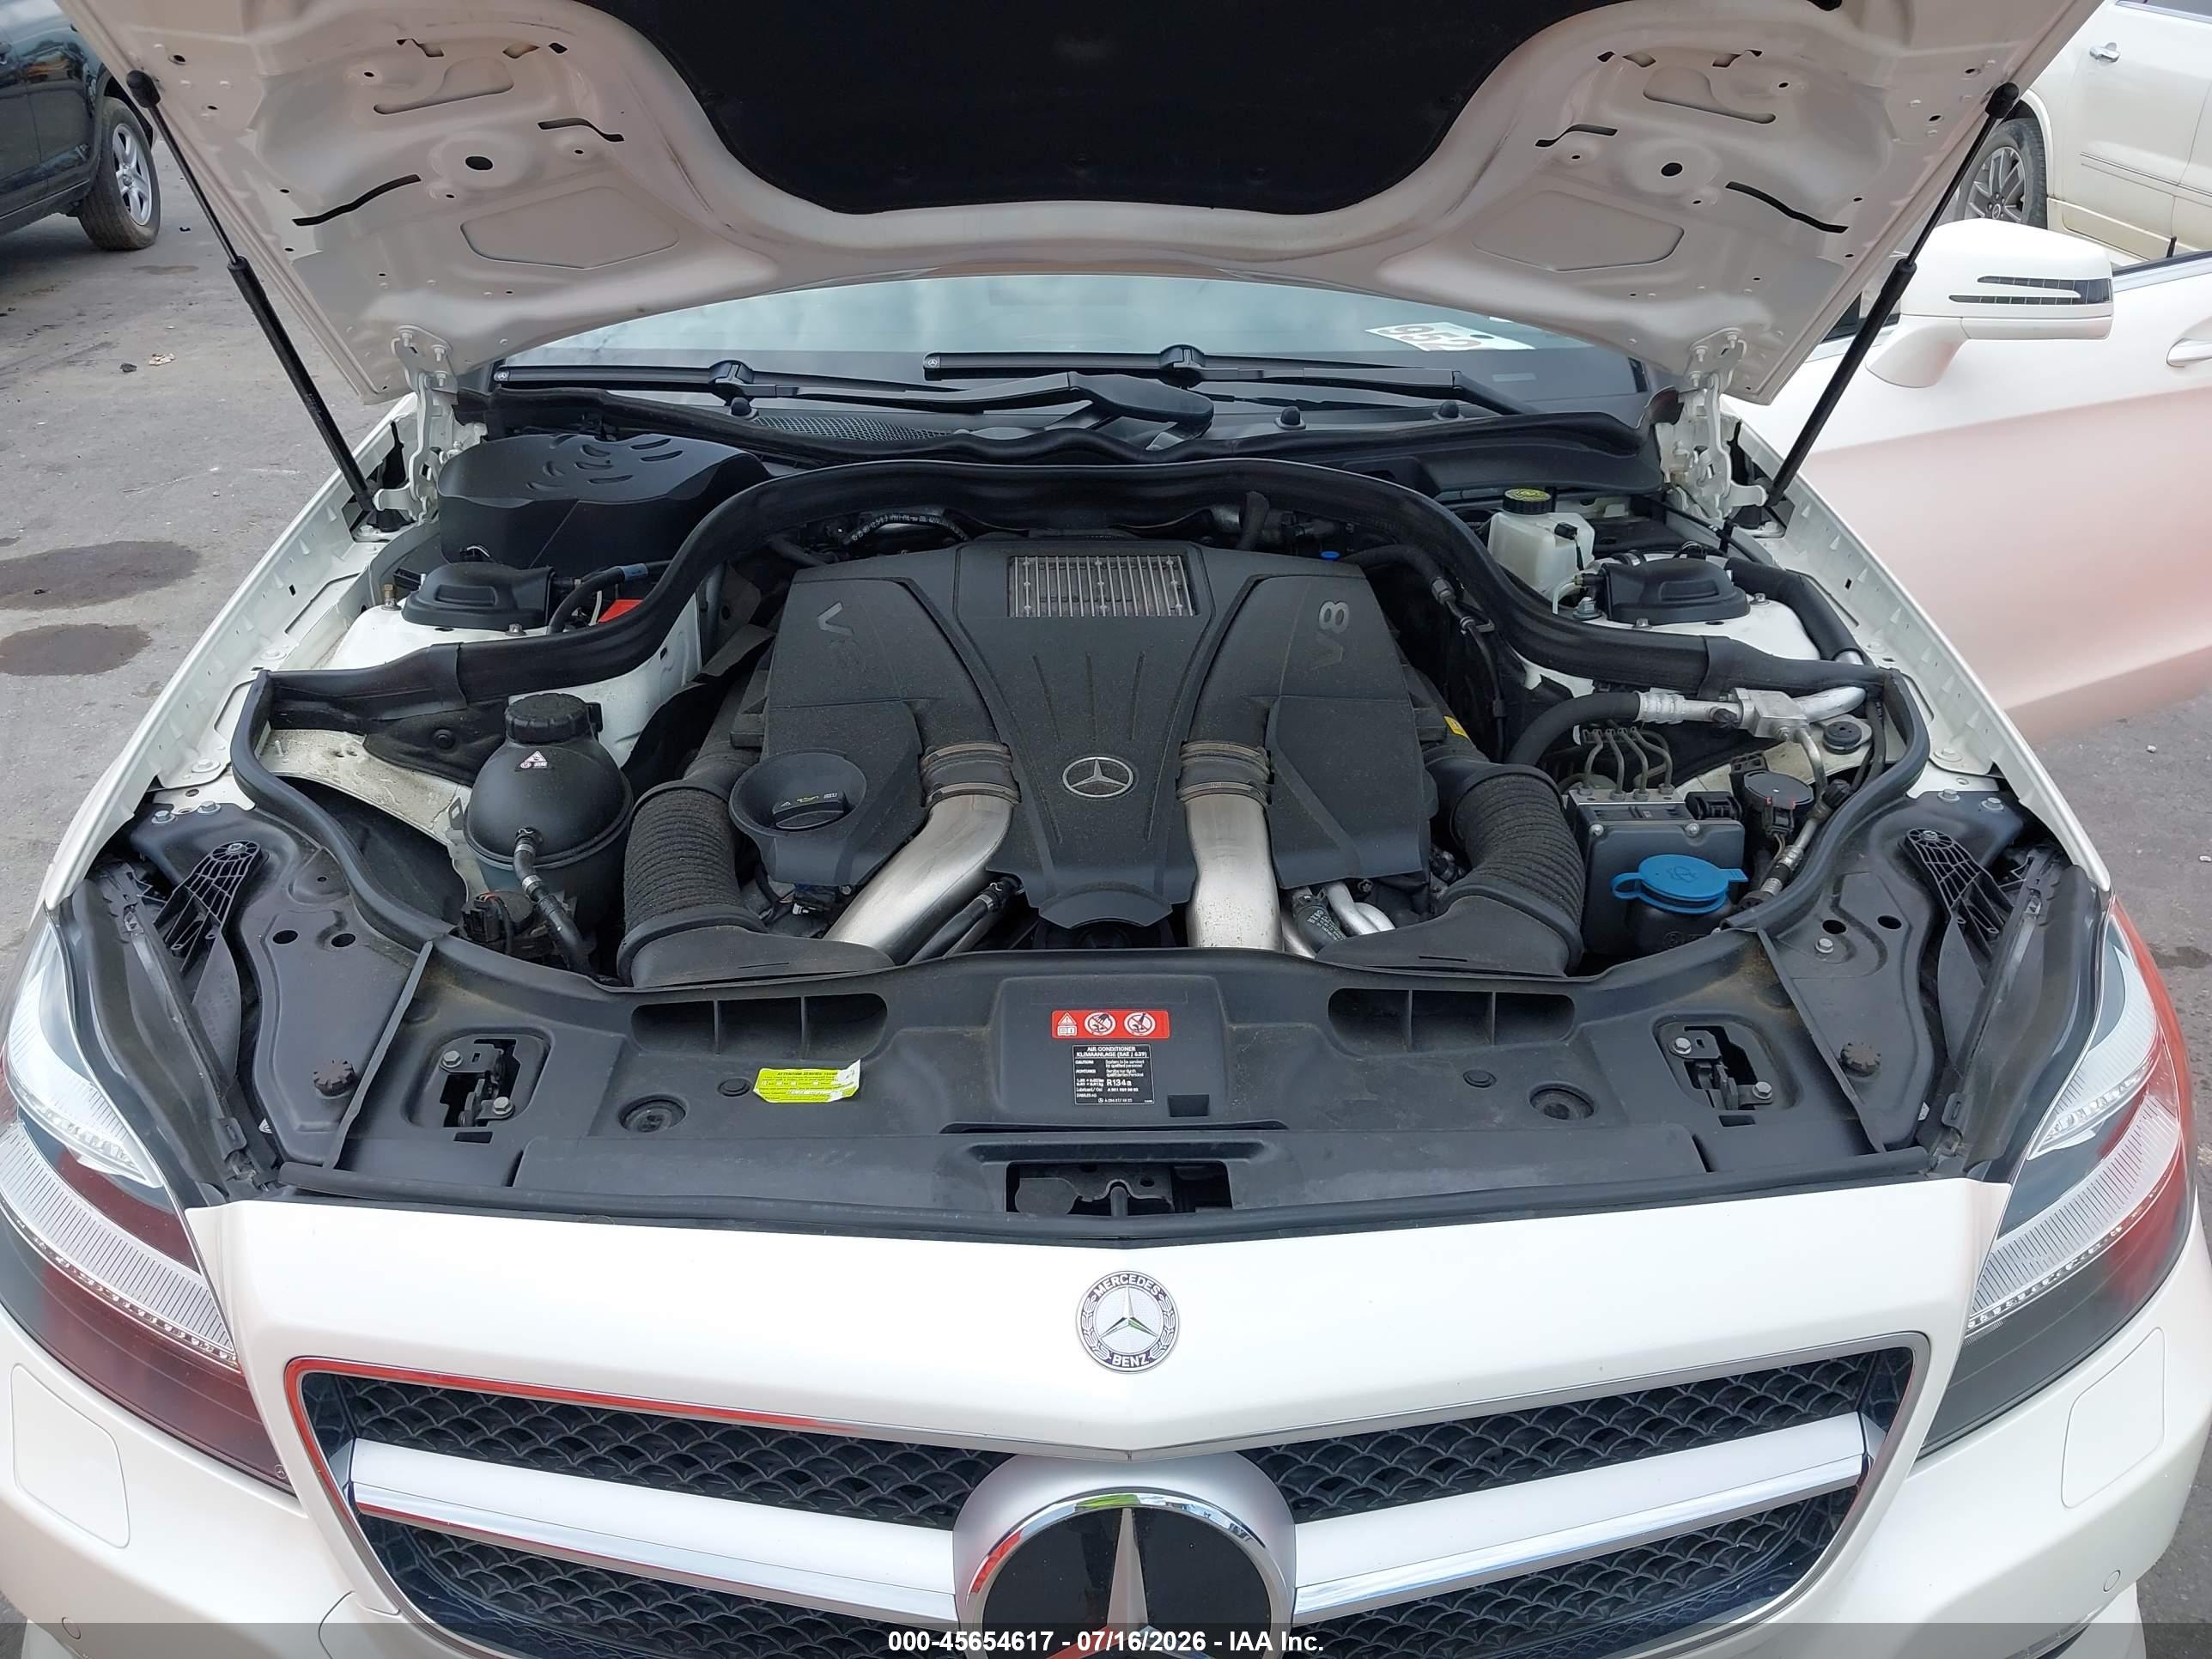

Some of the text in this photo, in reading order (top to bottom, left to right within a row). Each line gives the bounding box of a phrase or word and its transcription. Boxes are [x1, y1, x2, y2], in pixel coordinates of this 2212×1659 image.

[1377, 325, 1494, 350] 952
[1093, 1273, 1161, 1297] MERCEDES
[1112, 1353, 1149, 1367] BENZ
